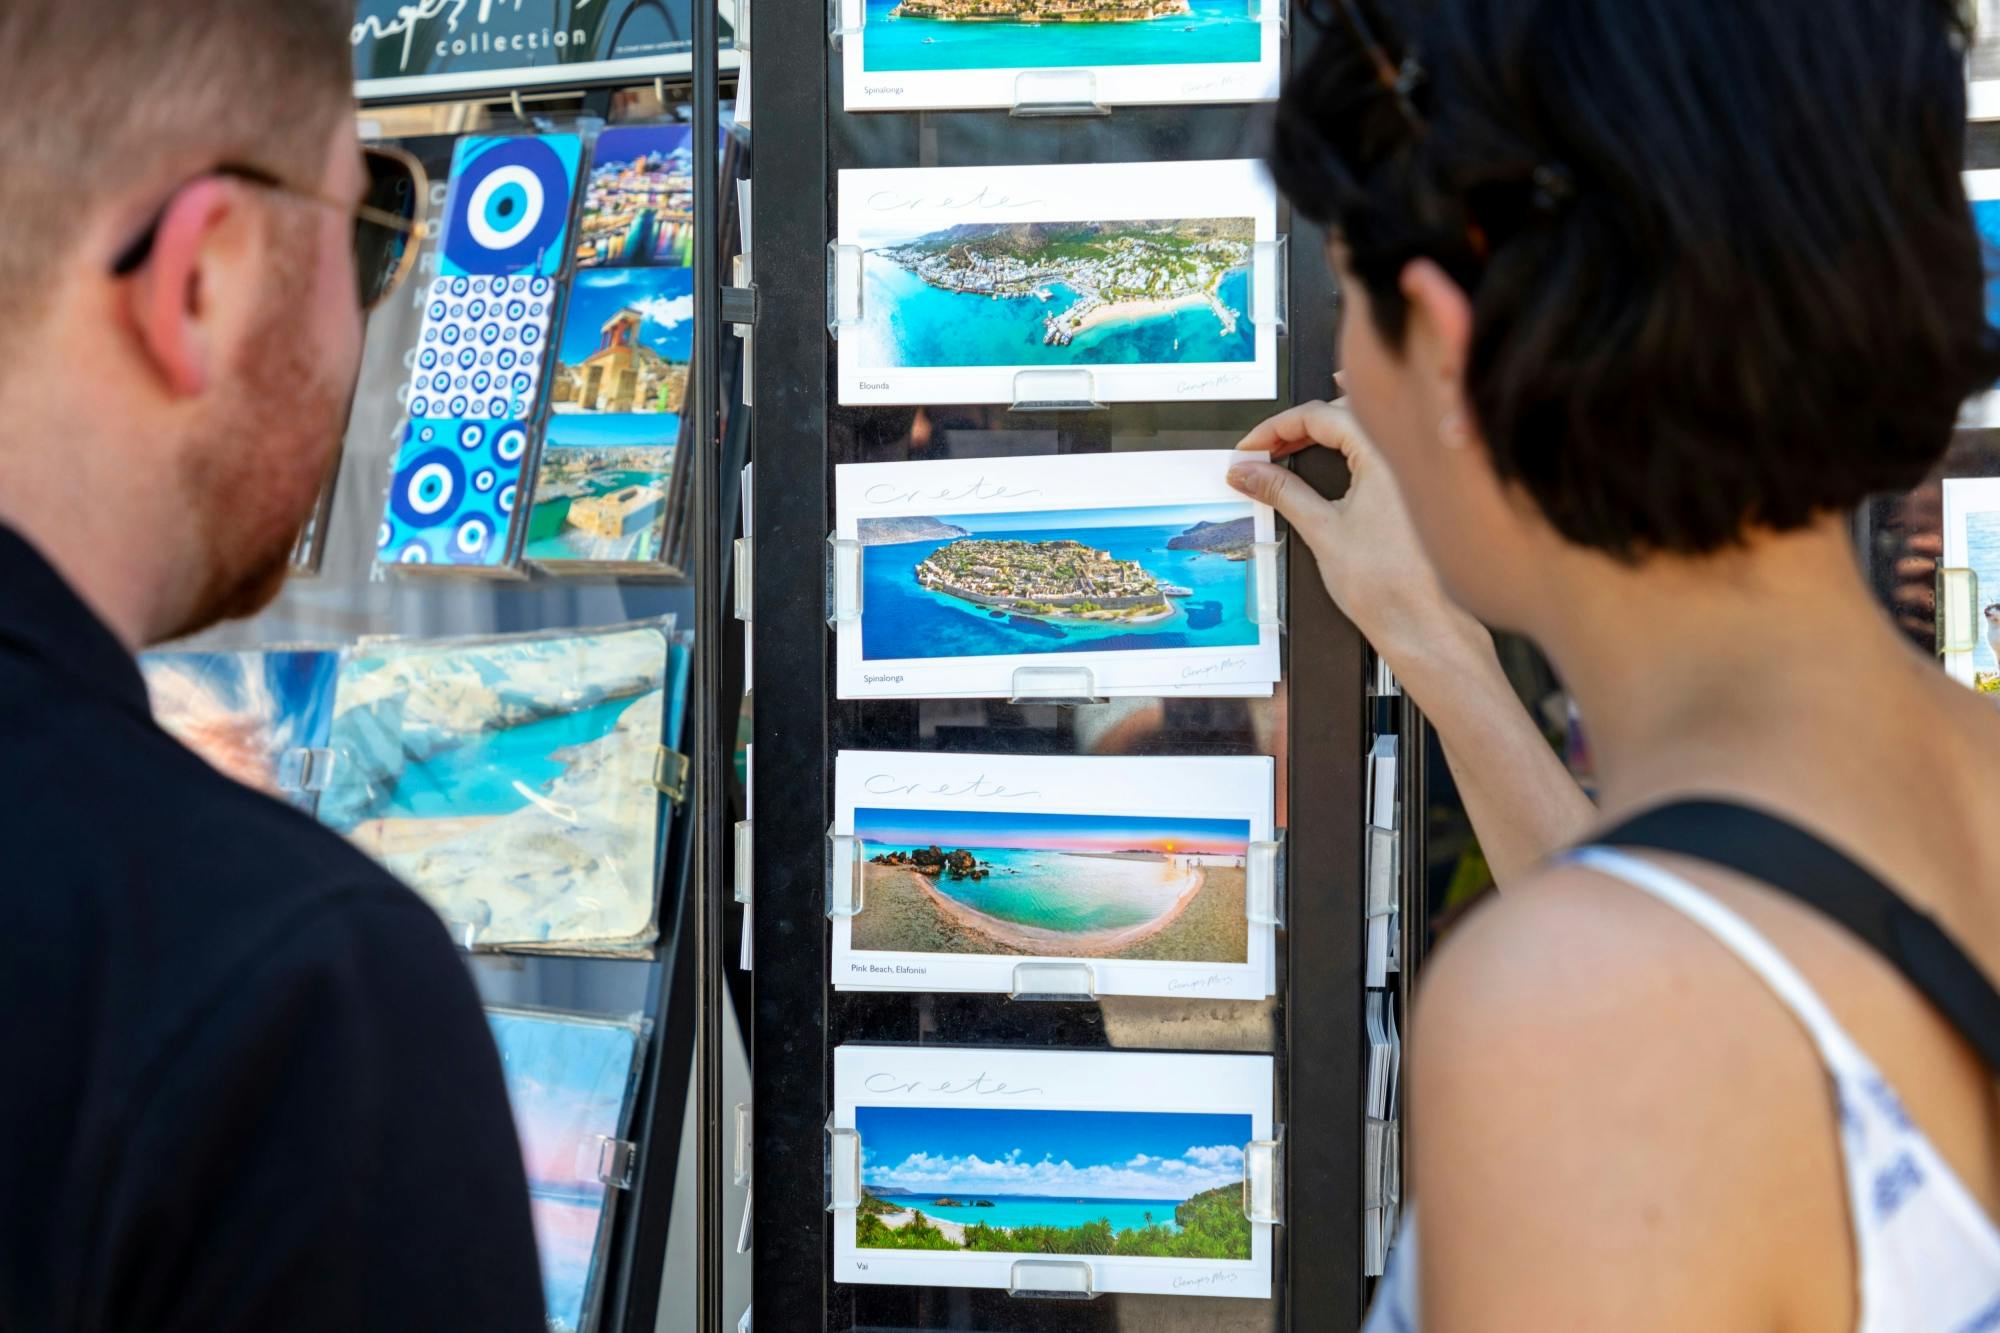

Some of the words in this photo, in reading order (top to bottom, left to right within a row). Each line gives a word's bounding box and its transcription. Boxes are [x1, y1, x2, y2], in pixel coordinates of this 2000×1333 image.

[435, 28, 587, 57] collection
[863, 86, 904, 96] Spinalonga
[859, 381, 890, 391] Elounda
[865, 475, 1043, 505] Crete
[863, 674, 904, 684] Spinalonga
[864, 774, 1042, 799] Crete
[851, 964, 868, 972] Pink
[870, 965, 894, 973] Beach,
[896, 966, 927, 974] Elafonisi
[864, 1071, 1044, 1096] Crete
[856, 1262, 869, 1271] Vai
